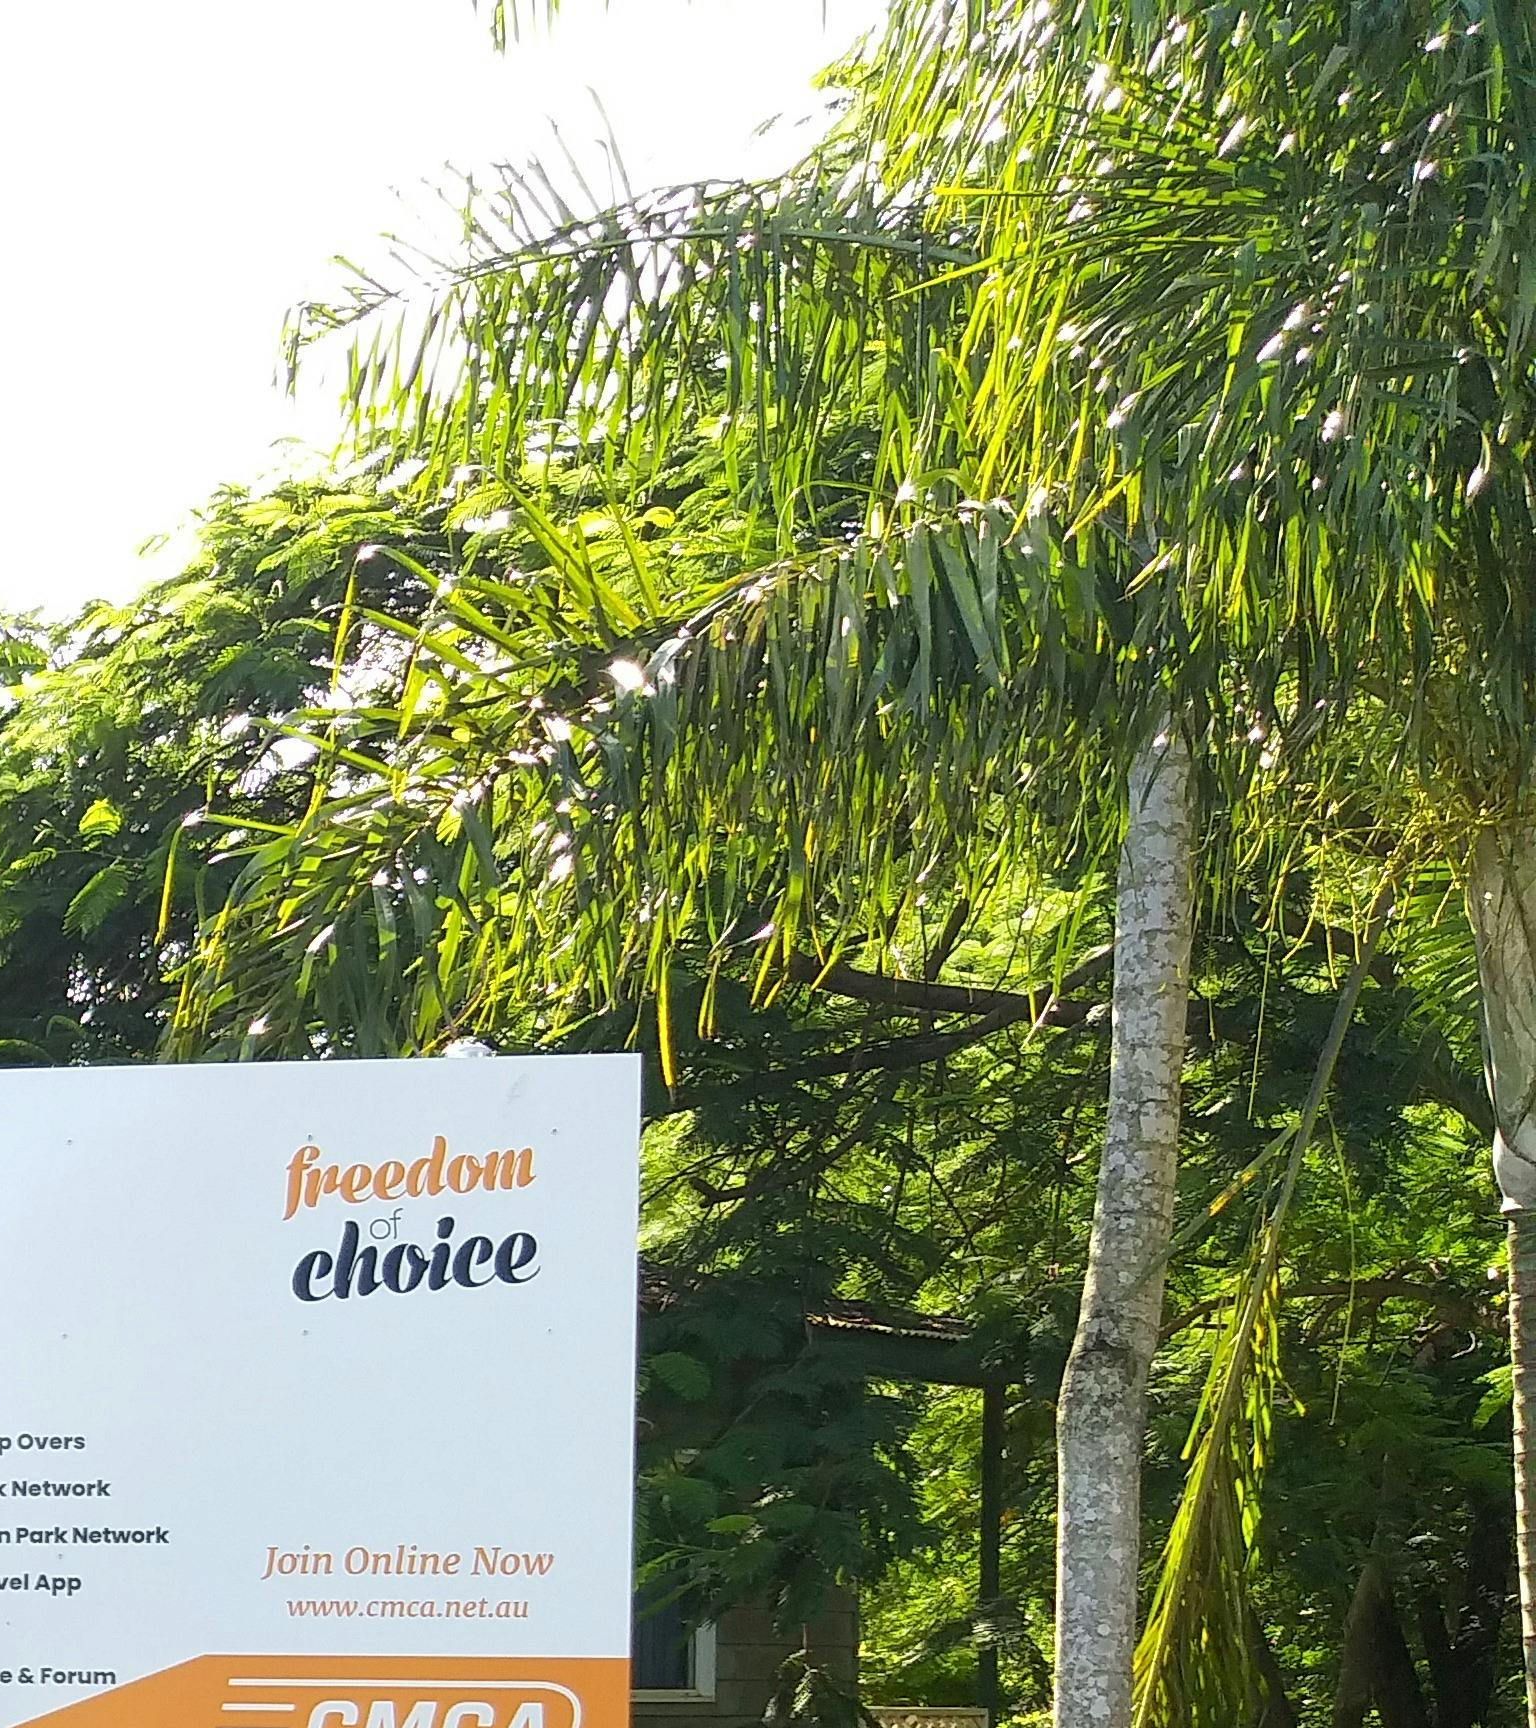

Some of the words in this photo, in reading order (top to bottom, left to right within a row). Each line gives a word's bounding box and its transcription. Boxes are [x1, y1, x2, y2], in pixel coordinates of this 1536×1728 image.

[283, 1135, 536, 1220] freedom
[369, 1207, 403, 1239] of
[292, 1213, 540, 1301] choice
[16, 1433, 85, 1450] Overs
[11, 1479, 110, 1496] Network
[16, 1526, 68, 1543] Park
[72, 1526, 169, 1543] Network
[261, 1544, 332, 1580] Join
[345, 1544, 460, 1574] Online
[470, 1547, 554, 1575] Now
[34, 1574, 81, 1596] App
[286, 1597, 528, 1618] www.cmca.net.au
[18, 1667, 34, 1683] &
[40, 1667, 116, 1684] Forum
